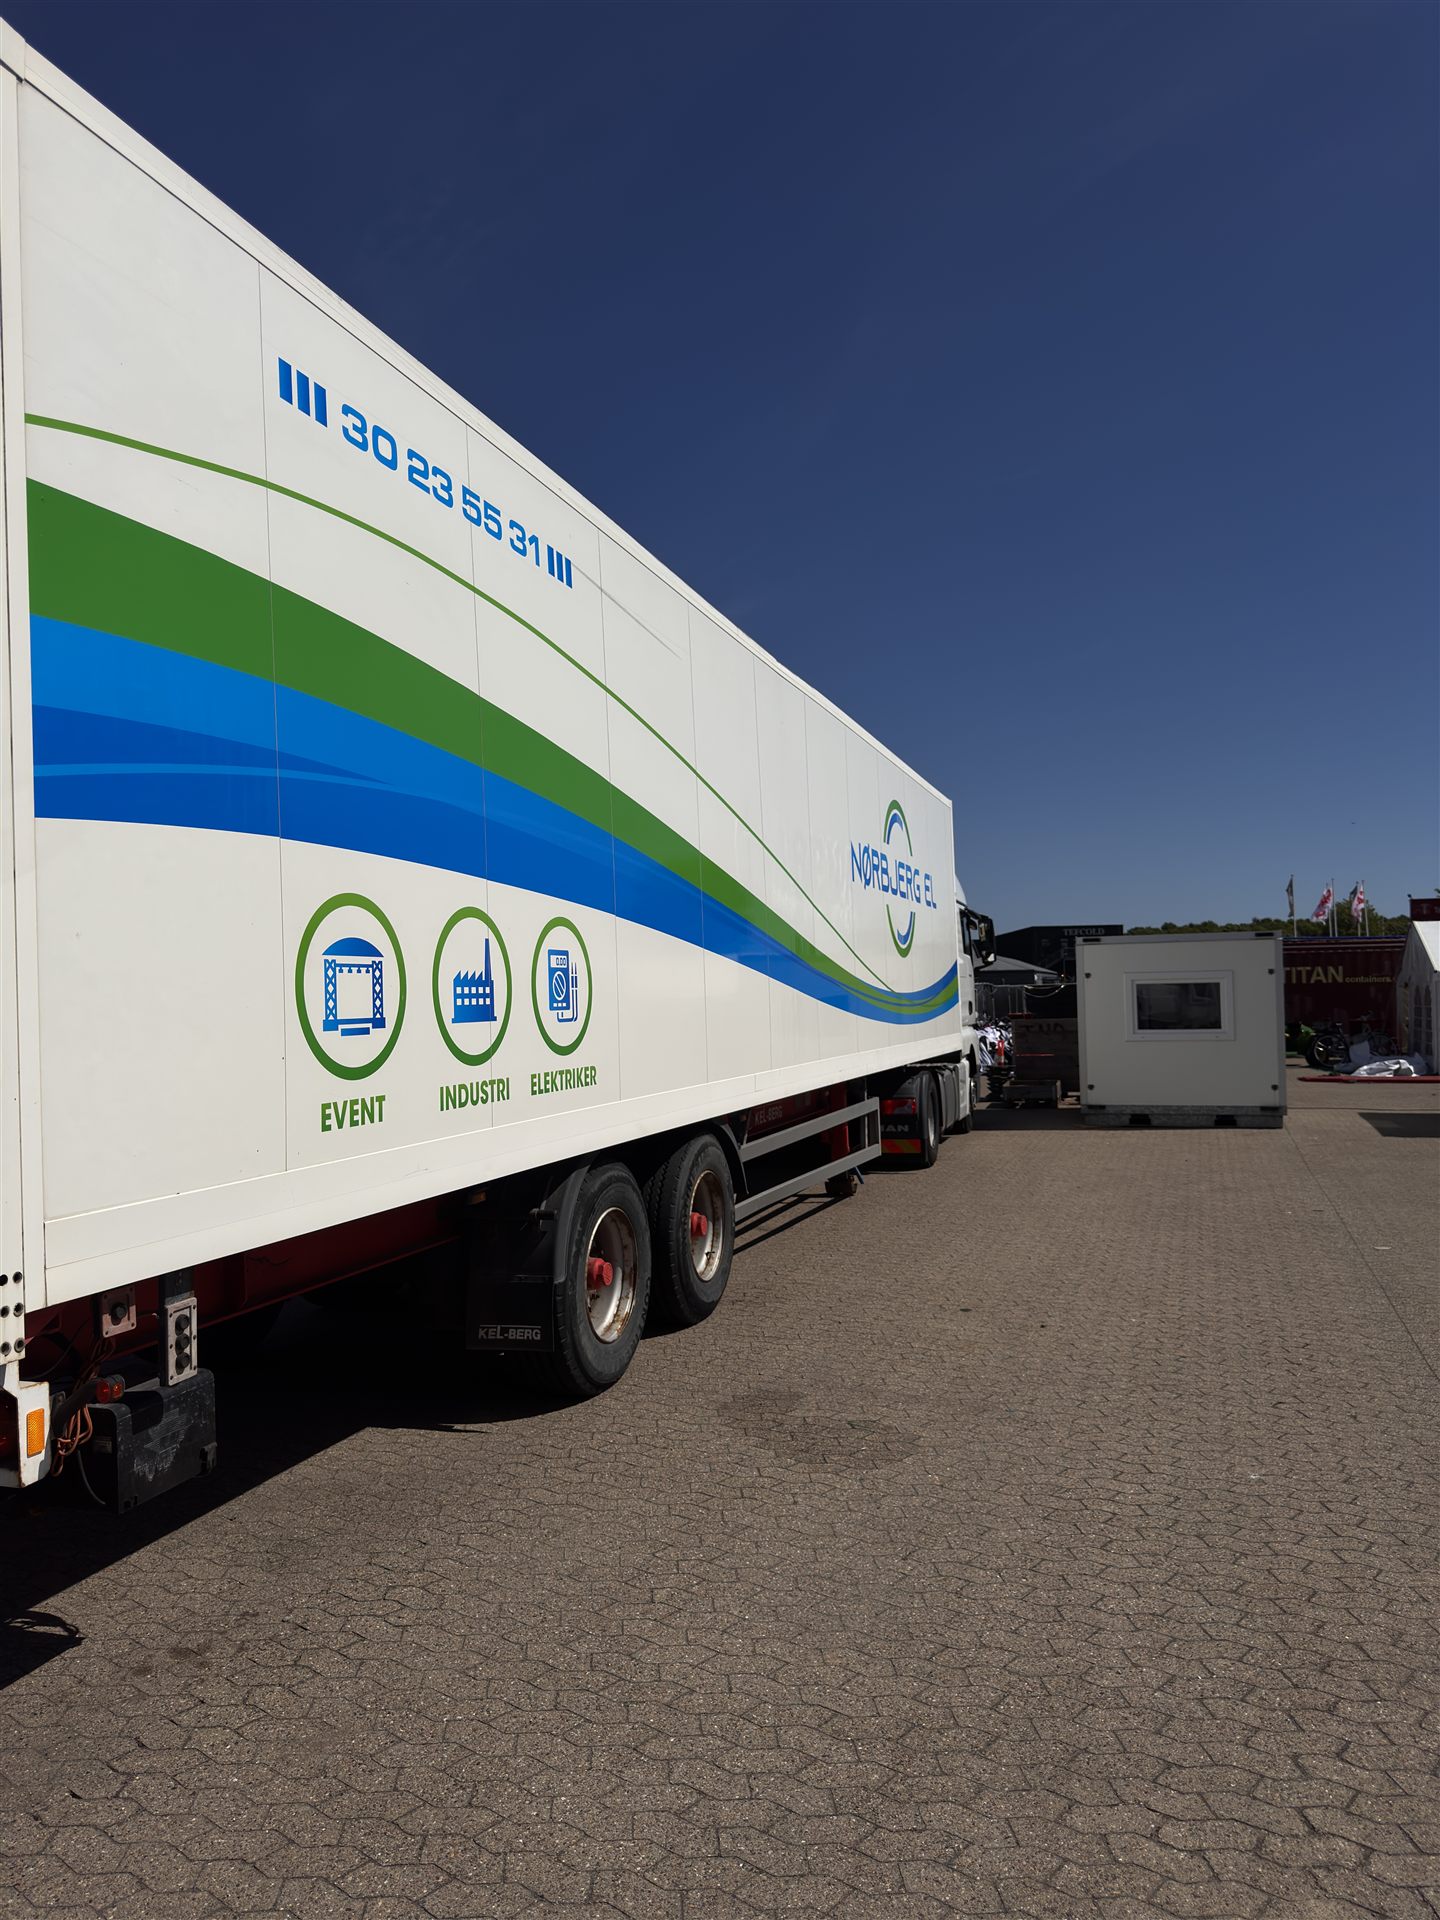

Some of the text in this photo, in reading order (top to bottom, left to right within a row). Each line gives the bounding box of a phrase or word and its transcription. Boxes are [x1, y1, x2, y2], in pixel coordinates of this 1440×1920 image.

[341, 403, 541, 567] 30 23 55 31
[851, 841, 937, 909] NØRBJERG EL
[439, 1077, 510, 1112] INDUSTRI
[530, 1065, 597, 1096] ELEKTRIKER
[320, 1094, 386, 1132] EVENT
[754, 1105, 783, 1126] KEL-BERG
[478, 1324, 542, 1341] KEL-BERG
